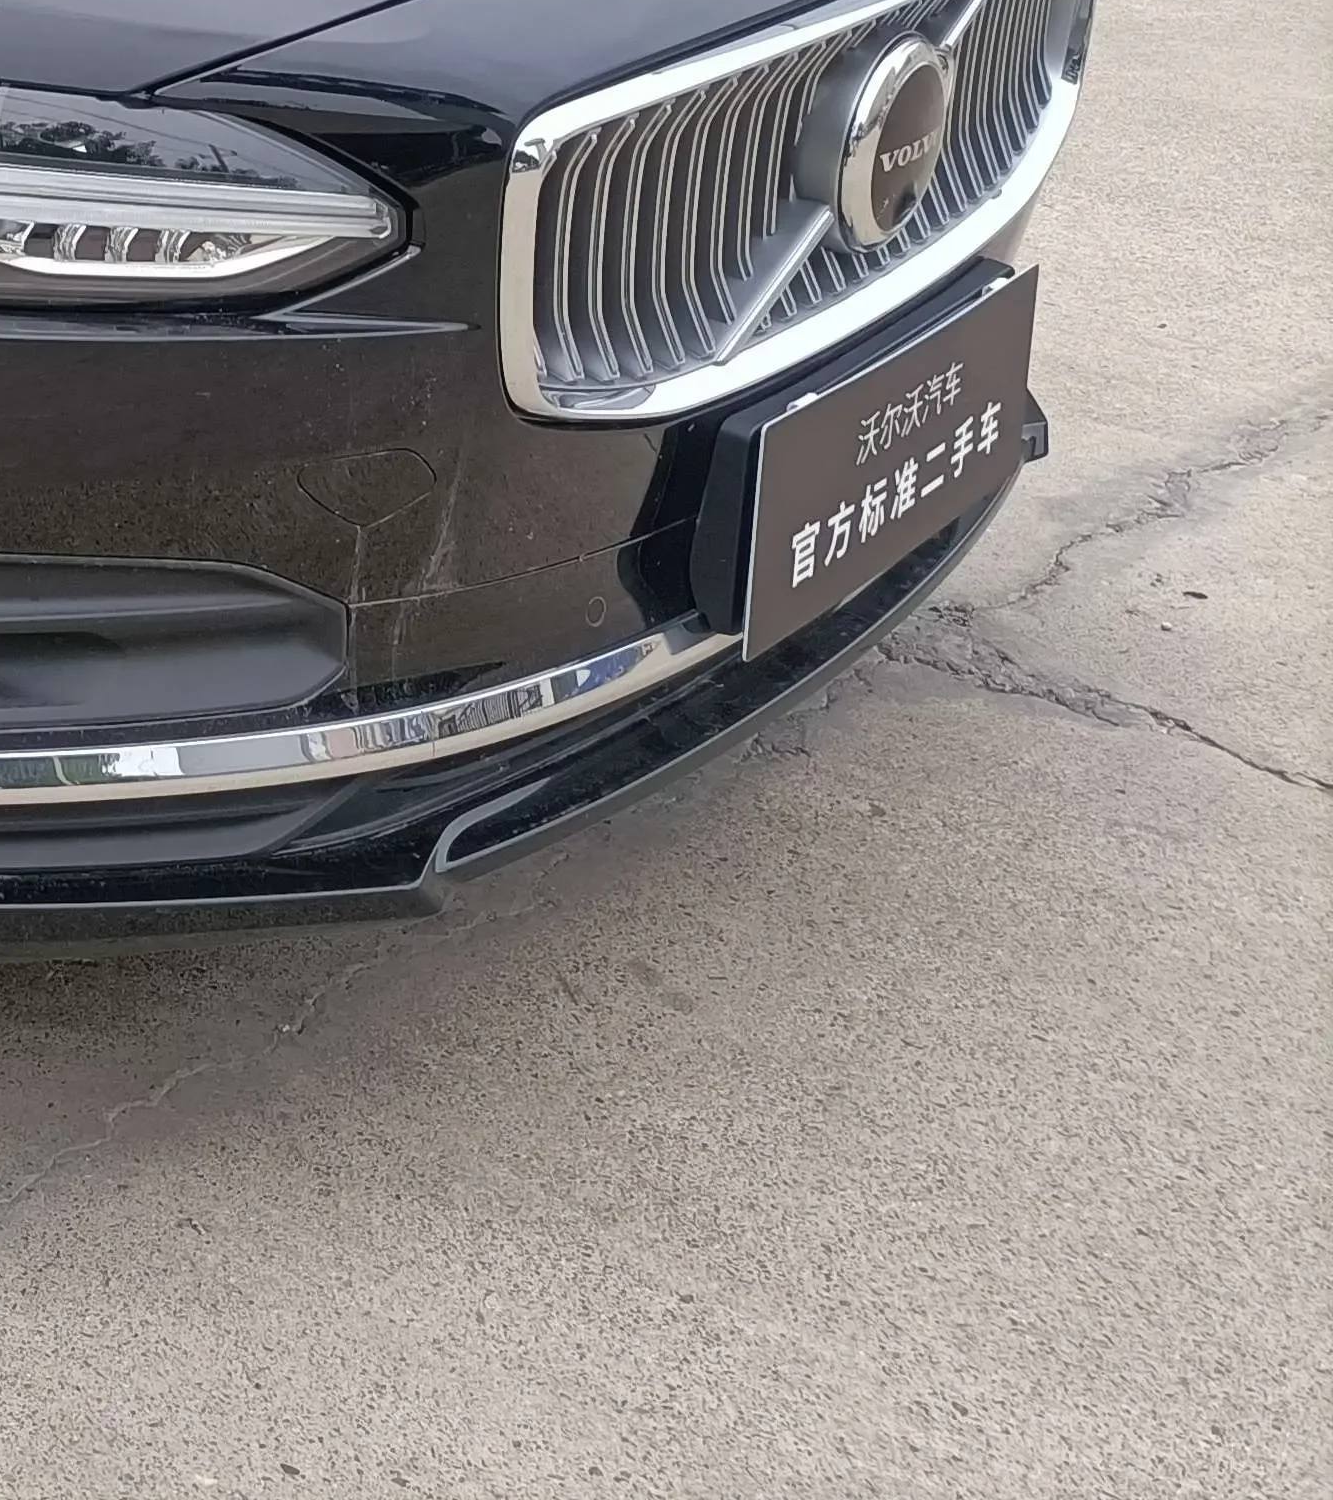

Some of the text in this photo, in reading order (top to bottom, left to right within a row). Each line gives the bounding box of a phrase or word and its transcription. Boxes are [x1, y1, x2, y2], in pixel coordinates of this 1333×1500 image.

[856, 362, 964, 466] 沃尔沃汽车
[791, 402, 1002, 588] 官方标准二手车
